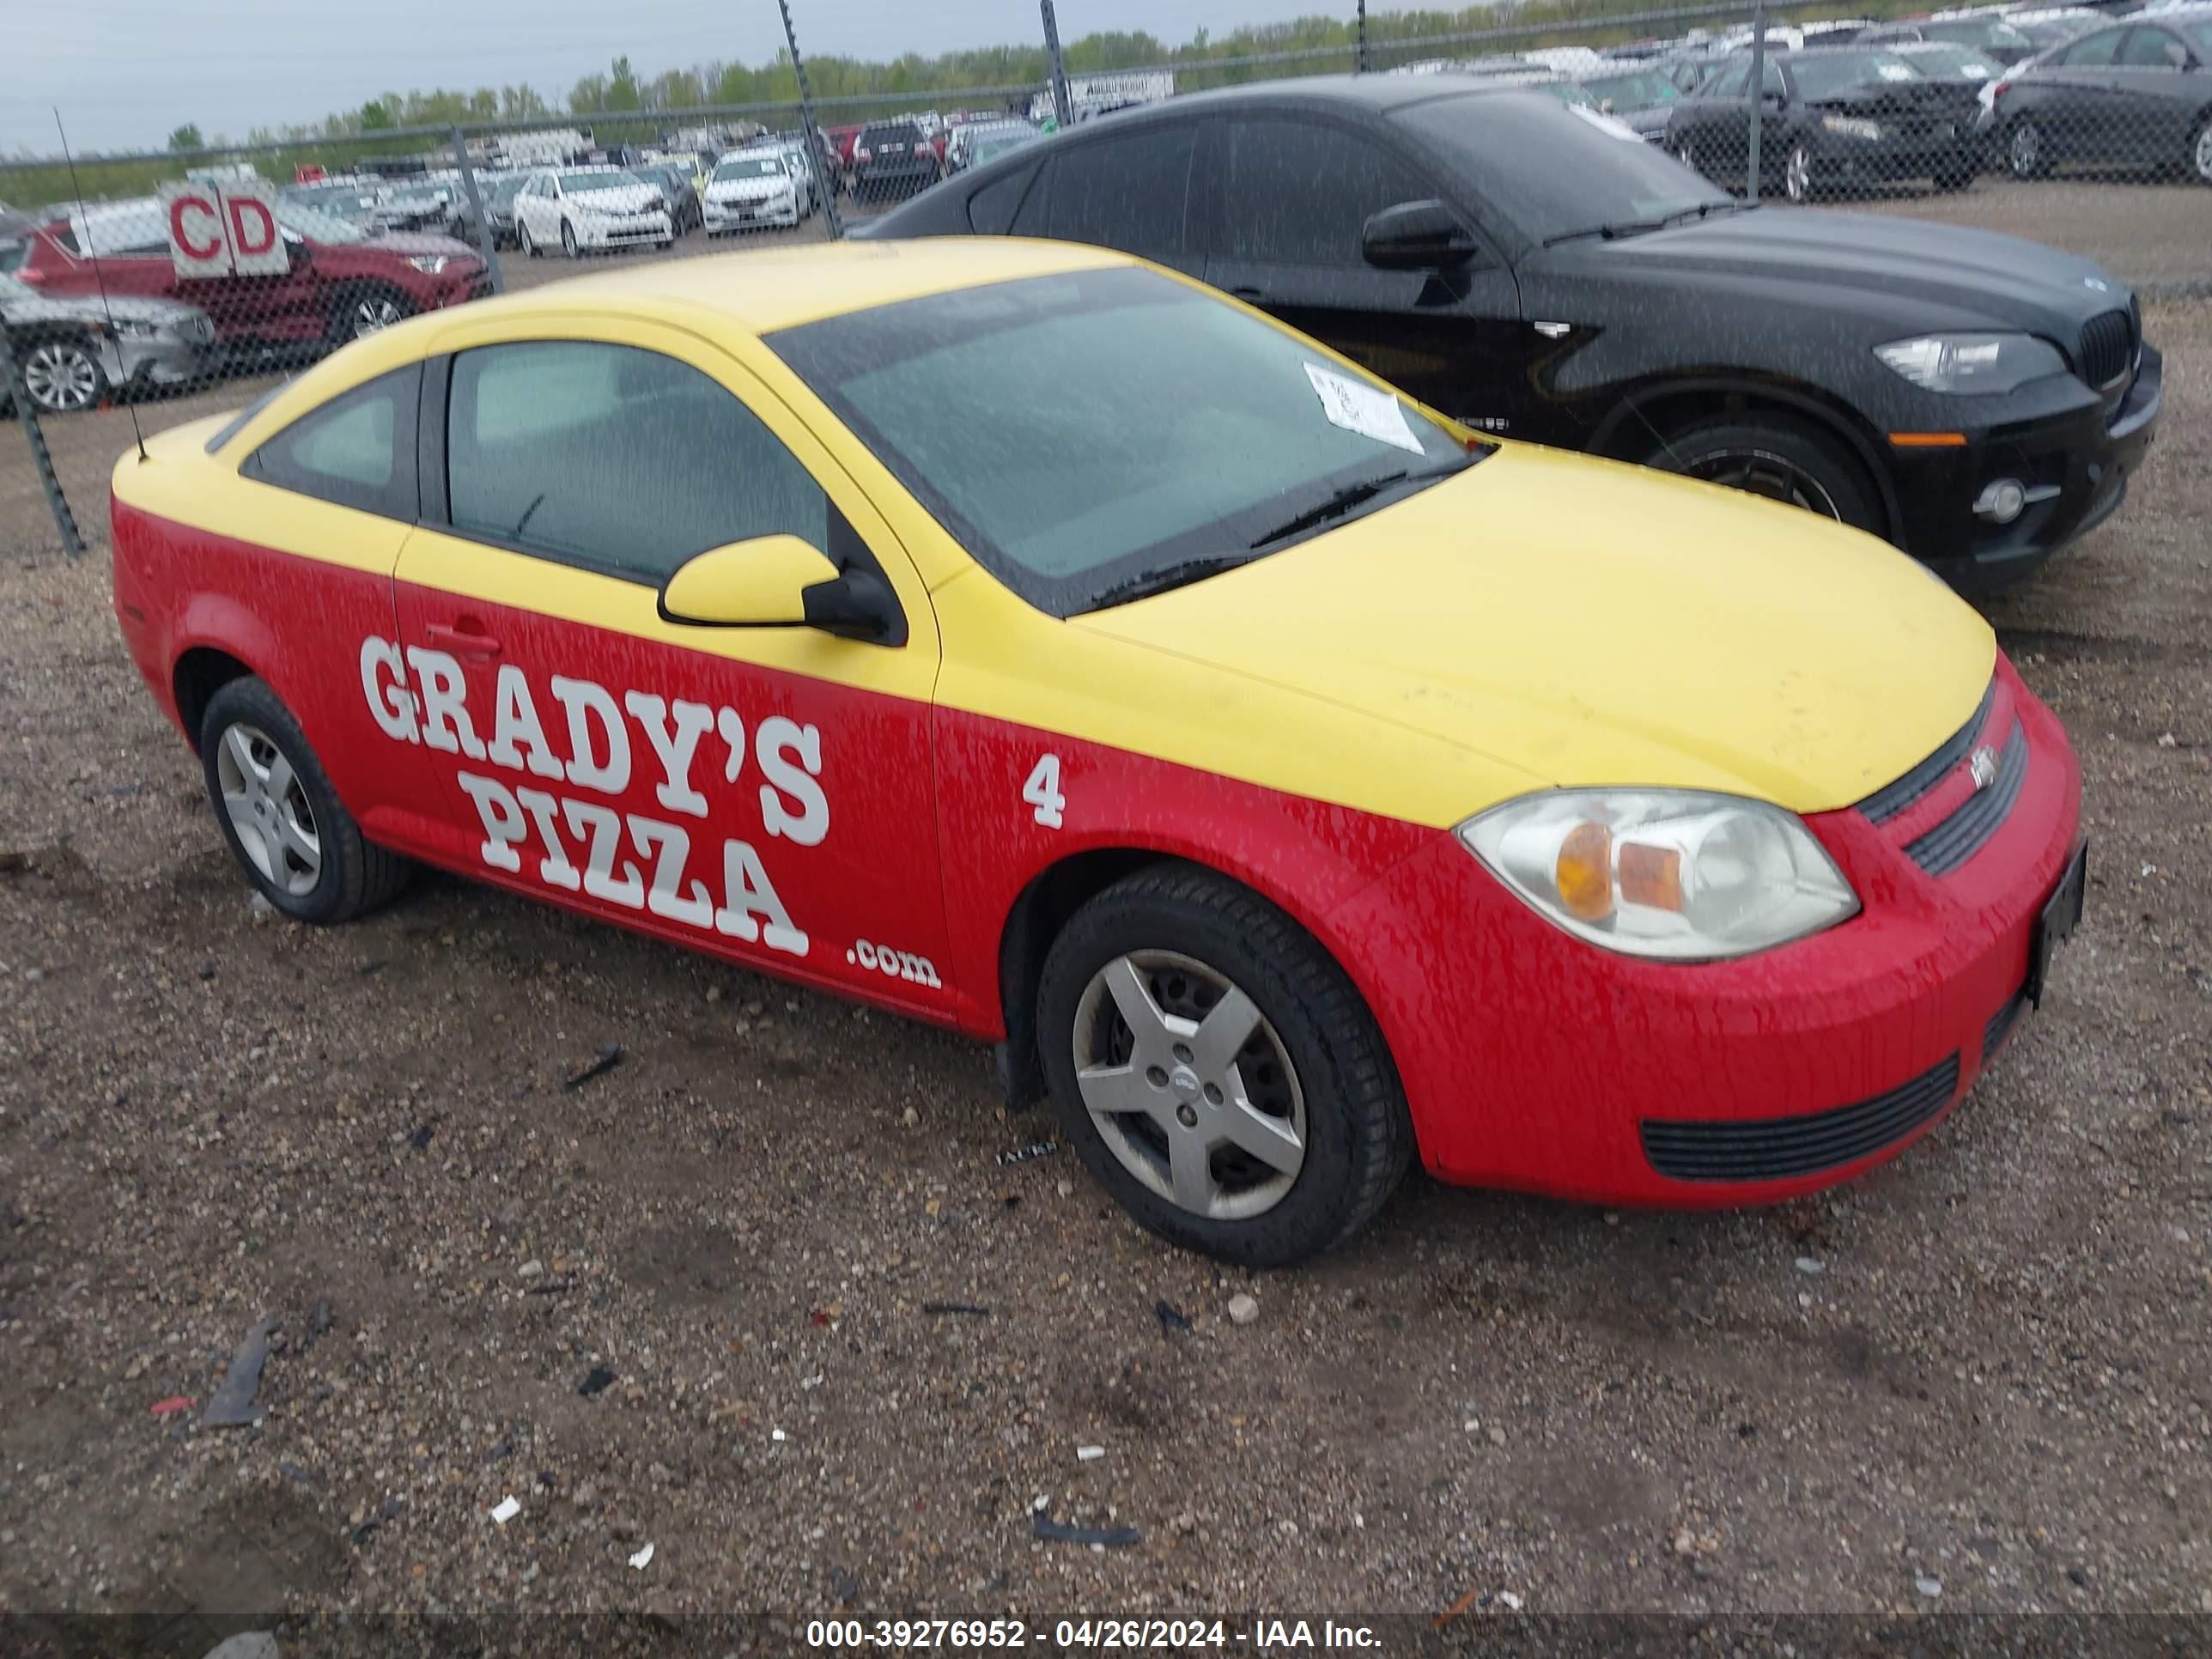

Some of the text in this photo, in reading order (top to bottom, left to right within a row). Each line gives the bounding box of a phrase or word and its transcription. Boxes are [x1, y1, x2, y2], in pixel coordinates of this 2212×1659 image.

[361, 635, 829, 845] GRADY'S
[1022, 754, 1066, 829] 4
[458, 772, 809, 955] PIZZA
[846, 938, 941, 989] .com
